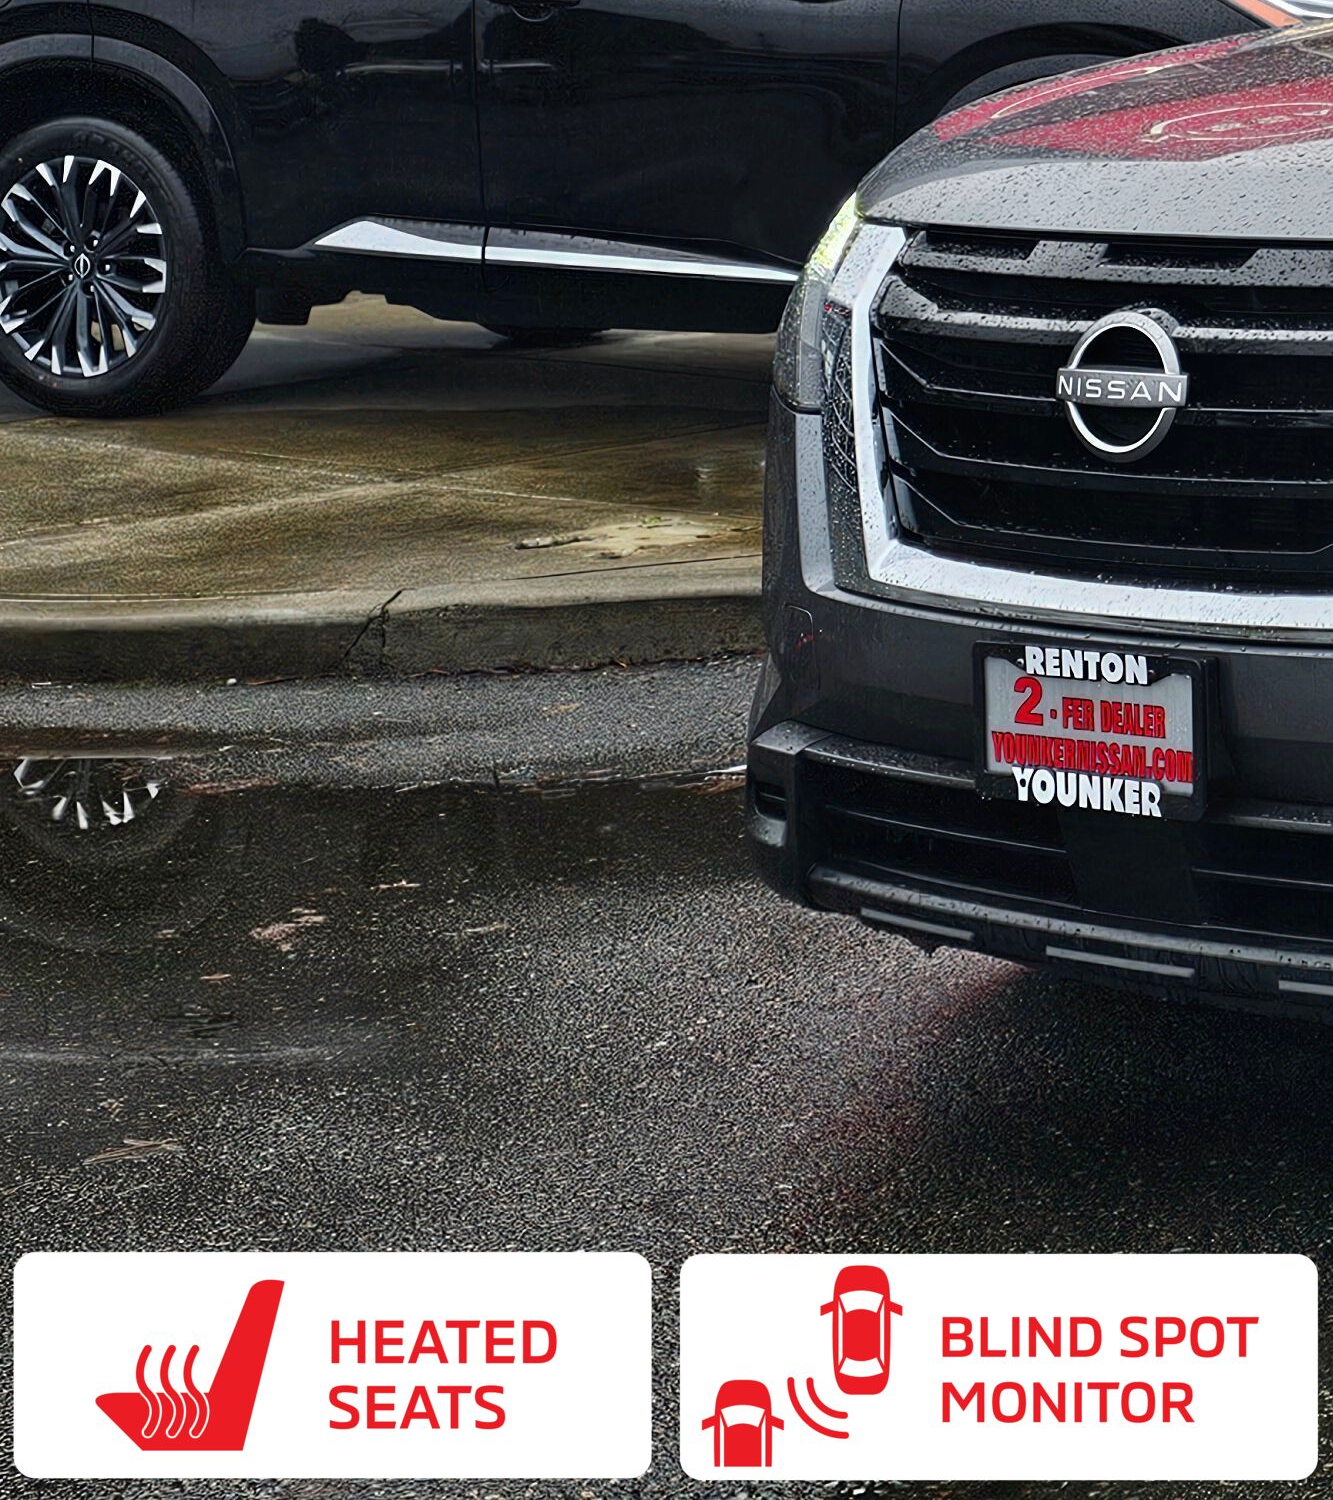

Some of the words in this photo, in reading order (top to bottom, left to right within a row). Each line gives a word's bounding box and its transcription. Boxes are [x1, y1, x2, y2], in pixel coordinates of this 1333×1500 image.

[1058, 375, 1182, 403] NISSAN
[1024, 645, 1149, 685] RENTON
[1100, 700, 1166, 739] DEALER
[991, 730, 1193, 784] YOUNKERNISSAN.COM
[1011, 765, 1163, 818] YOUNKER
